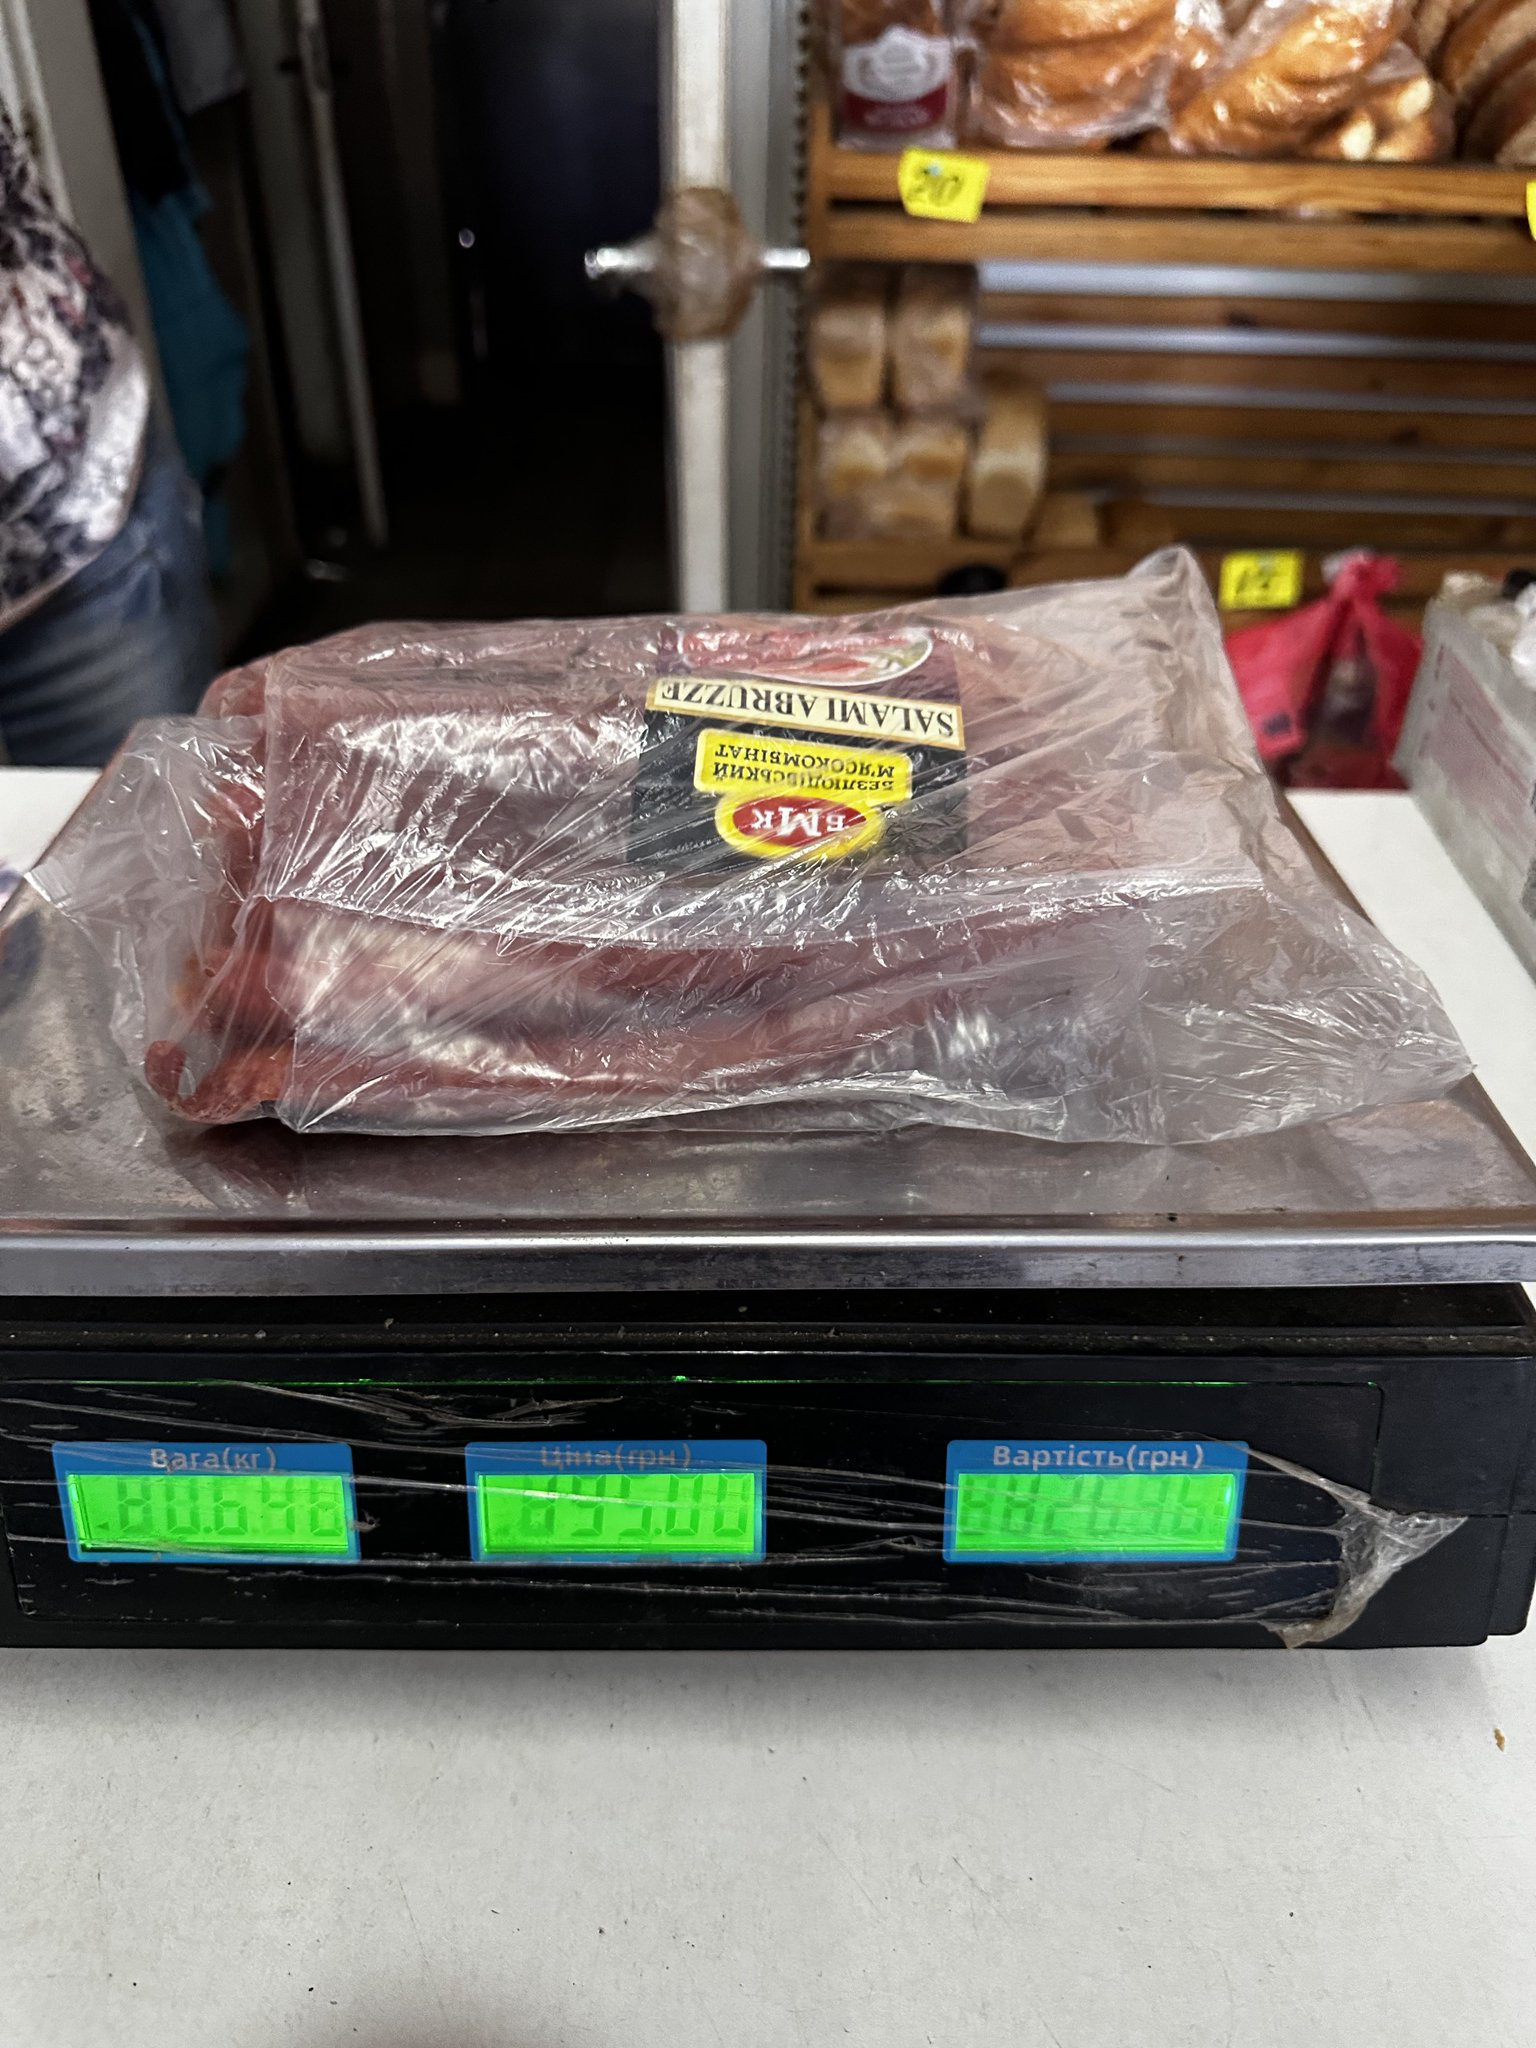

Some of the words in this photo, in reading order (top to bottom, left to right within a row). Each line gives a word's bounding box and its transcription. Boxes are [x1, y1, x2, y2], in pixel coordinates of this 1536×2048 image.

[661, 682, 819, 718] ABRUZZE
[823, 699, 955, 738] SALAMI
[993, 1445, 1205, 1471] Вартість(грн)
